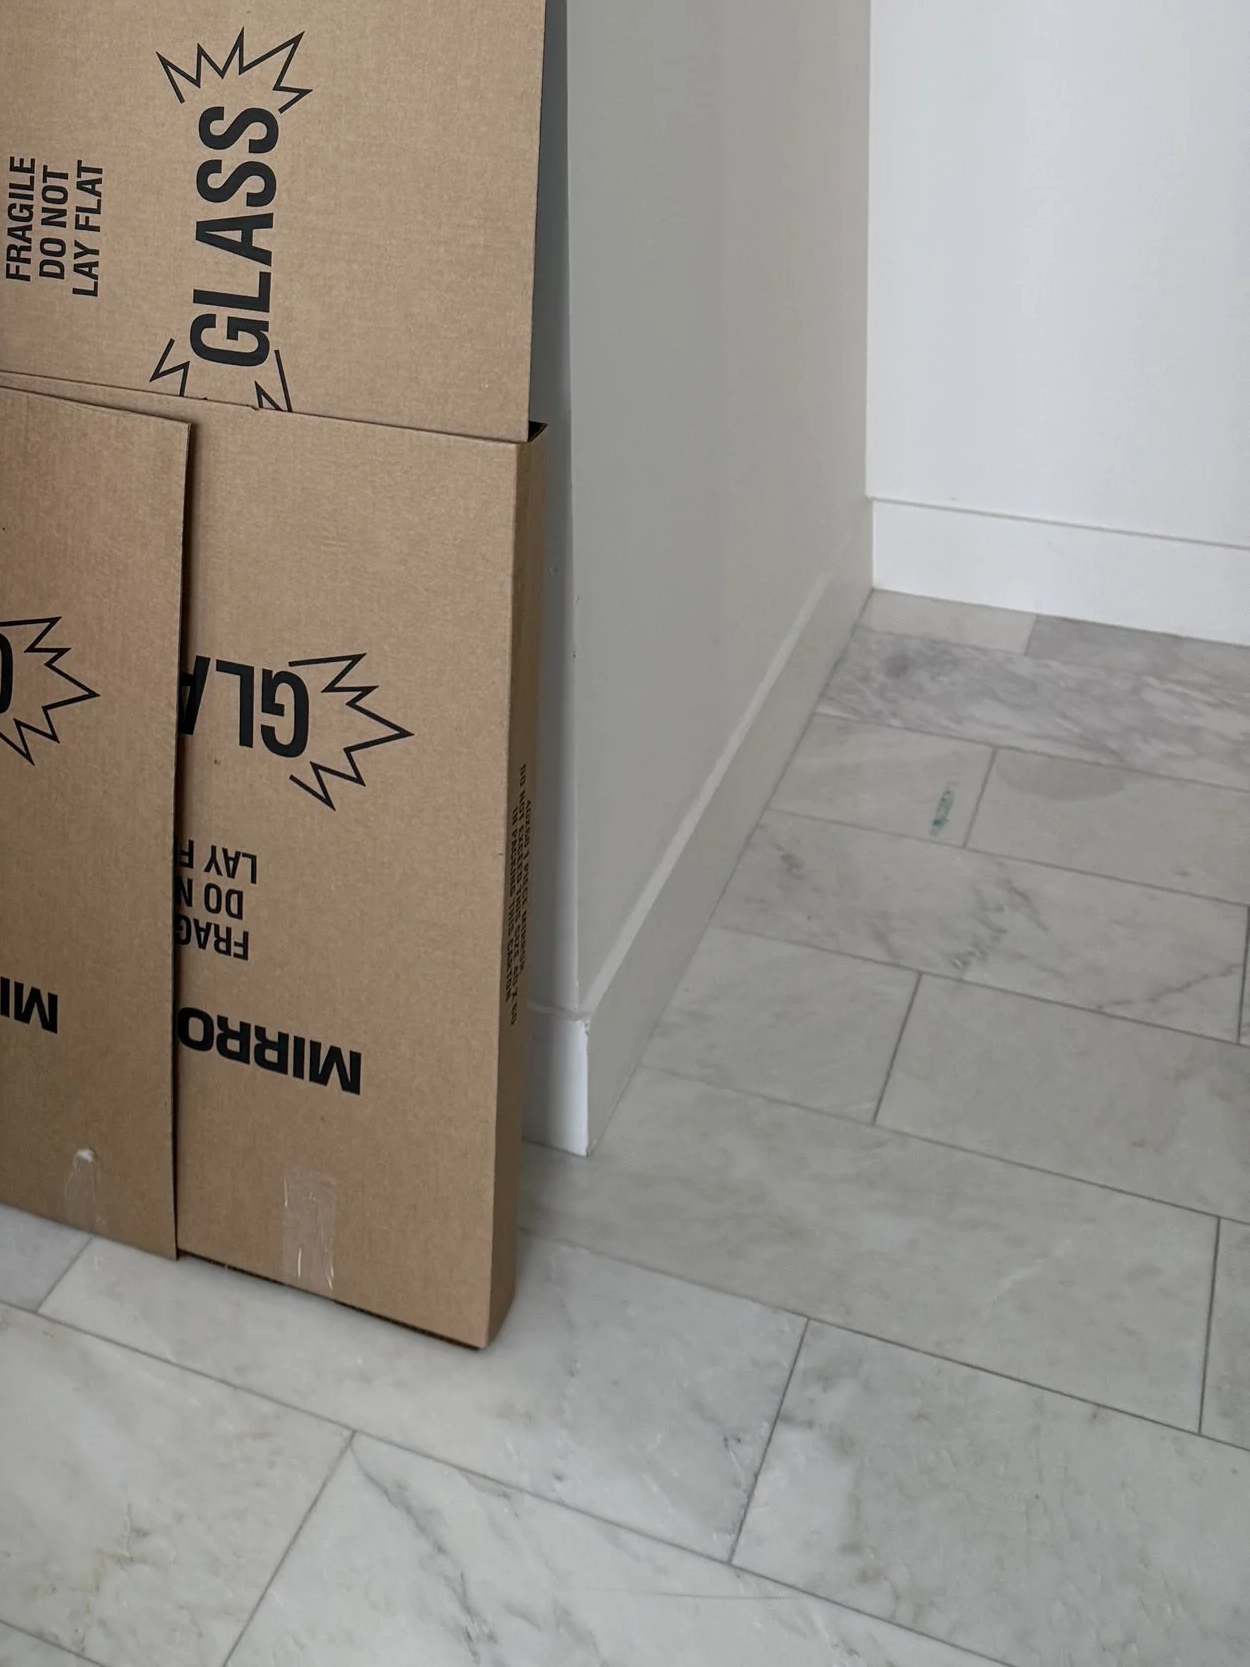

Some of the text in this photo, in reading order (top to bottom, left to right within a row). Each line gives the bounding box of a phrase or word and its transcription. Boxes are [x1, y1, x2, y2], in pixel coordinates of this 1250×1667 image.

[6, 156, 36, 282] FRAGILE
[39, 164, 69, 280] DO NOT
[72, 159, 103, 297] LAY FLAT
[190, 106, 280, 368] GLASS
[178, 655, 310, 758] GLA
[204, 845, 258, 884] LAY
[204, 883, 244, 920] DO
[174, 914, 250, 961] FRAG
[177, 1007, 362, 1095] MIRRO
